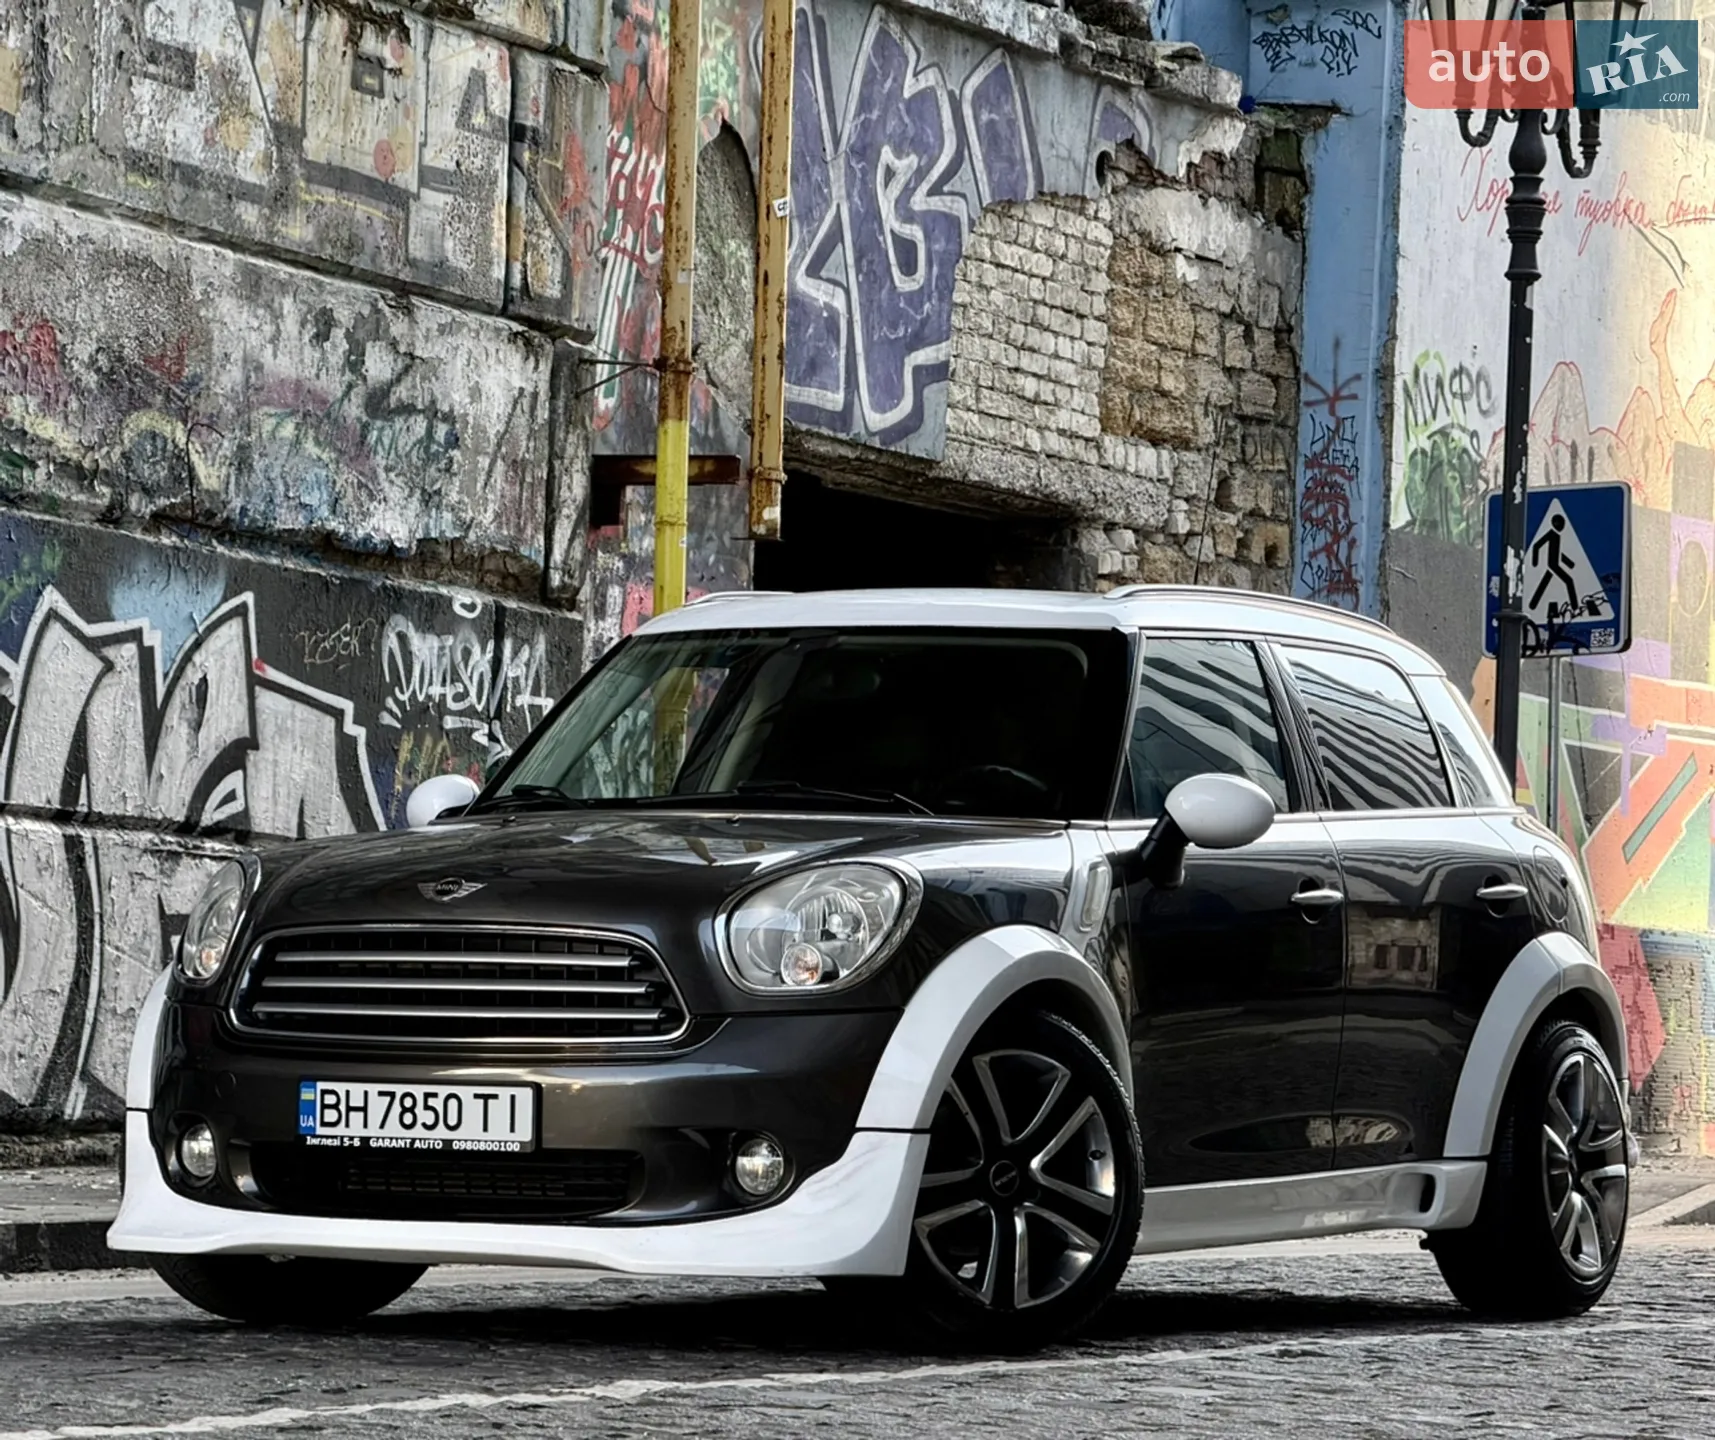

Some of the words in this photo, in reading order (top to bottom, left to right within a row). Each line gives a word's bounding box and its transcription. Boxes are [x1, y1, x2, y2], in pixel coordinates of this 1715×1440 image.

[319, 1089, 368, 1129] BH
[377, 1091, 463, 1131] 7850
[473, 1093, 516, 1133] TI
[300, 1114, 314, 1128] UA
[369, 1138, 412, 1149] GARANT
[413, 1139, 443, 1149] AUTO
[452, 1140, 520, 1152] 0980800100
